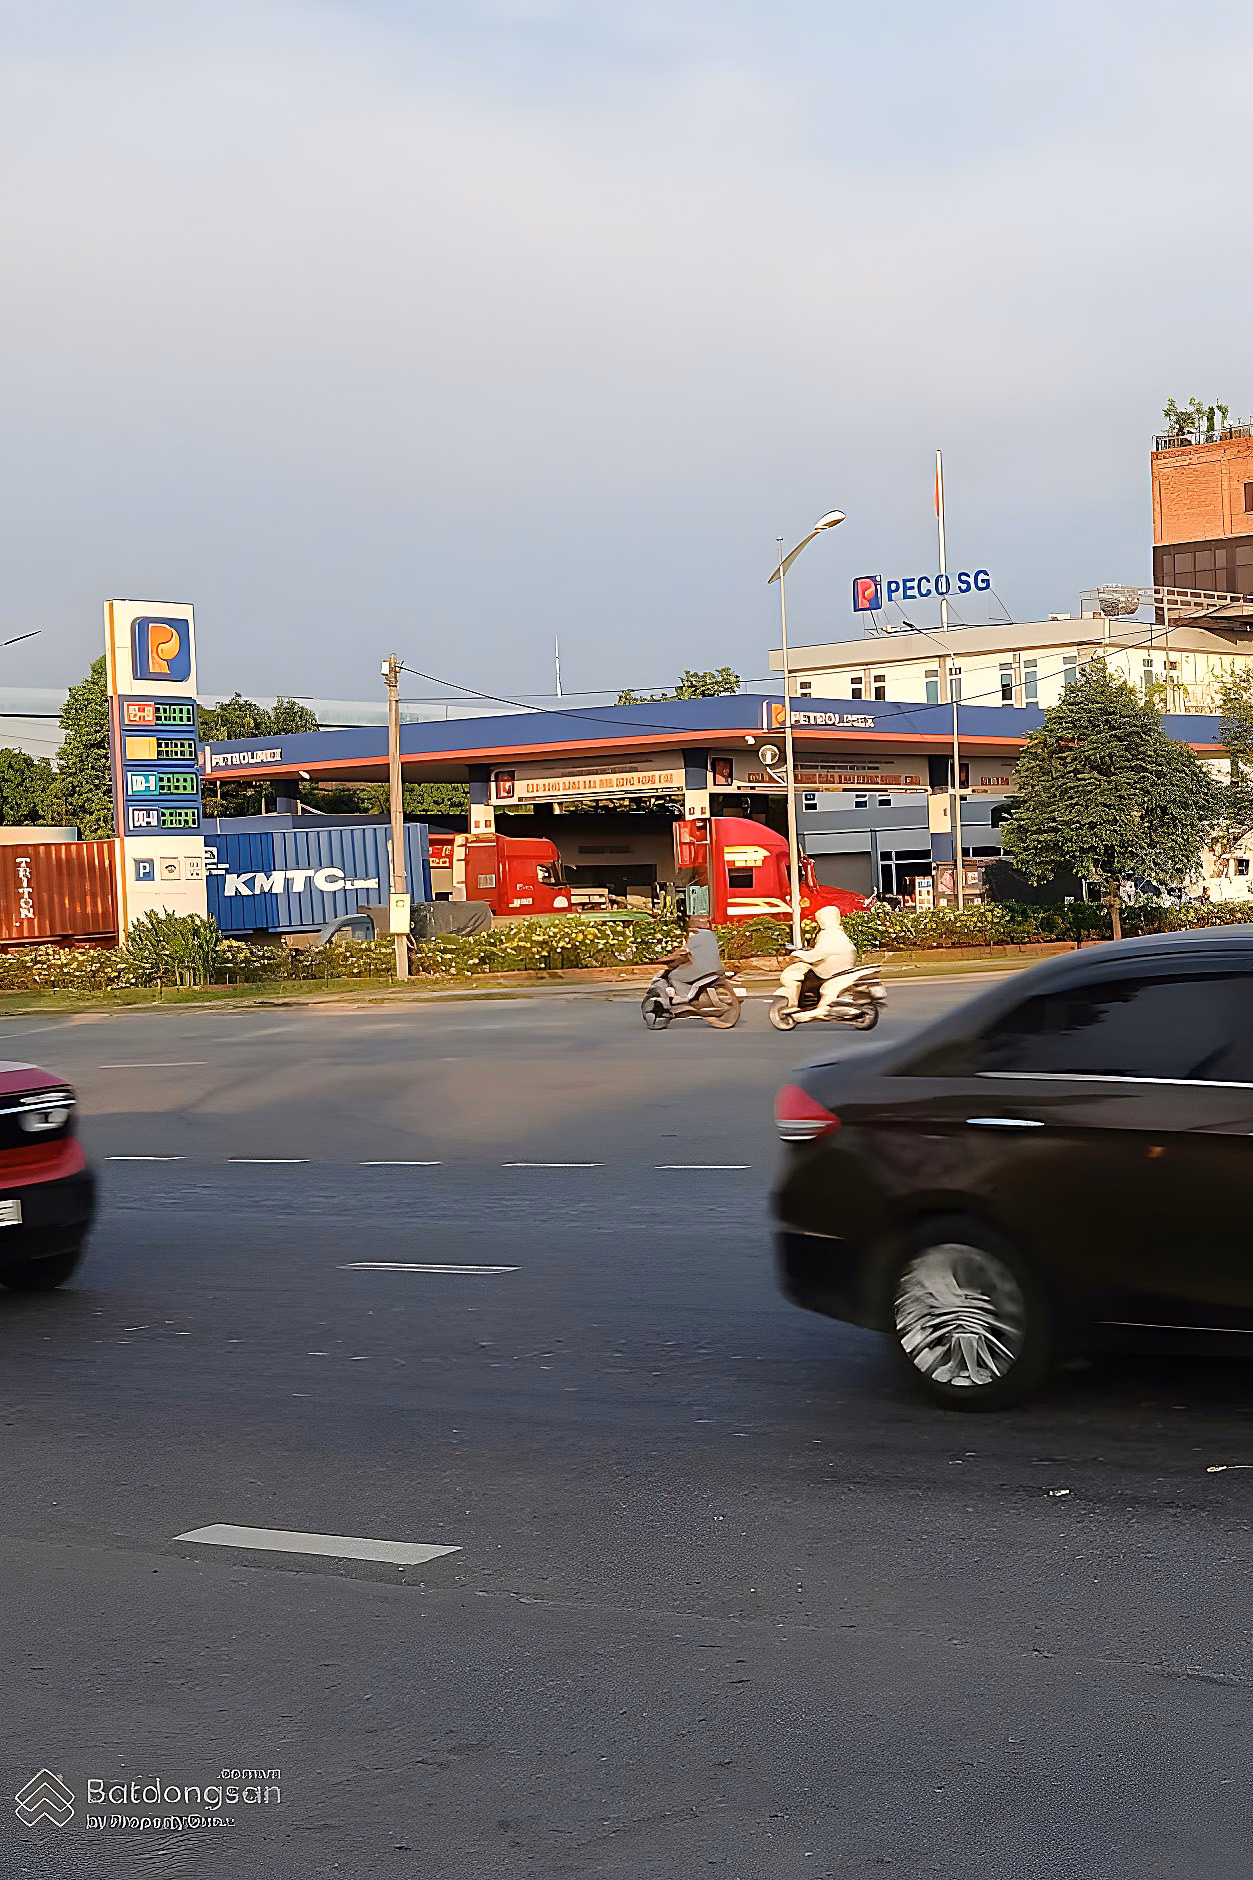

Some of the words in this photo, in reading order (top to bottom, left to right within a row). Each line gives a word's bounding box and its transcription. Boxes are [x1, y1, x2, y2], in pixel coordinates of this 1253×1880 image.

[887, 574, 950, 602] PECO
[957, 569, 991, 594] SG
[16, 857, 34, 919] TRITON
[224, 866, 346, 897] KMTC
